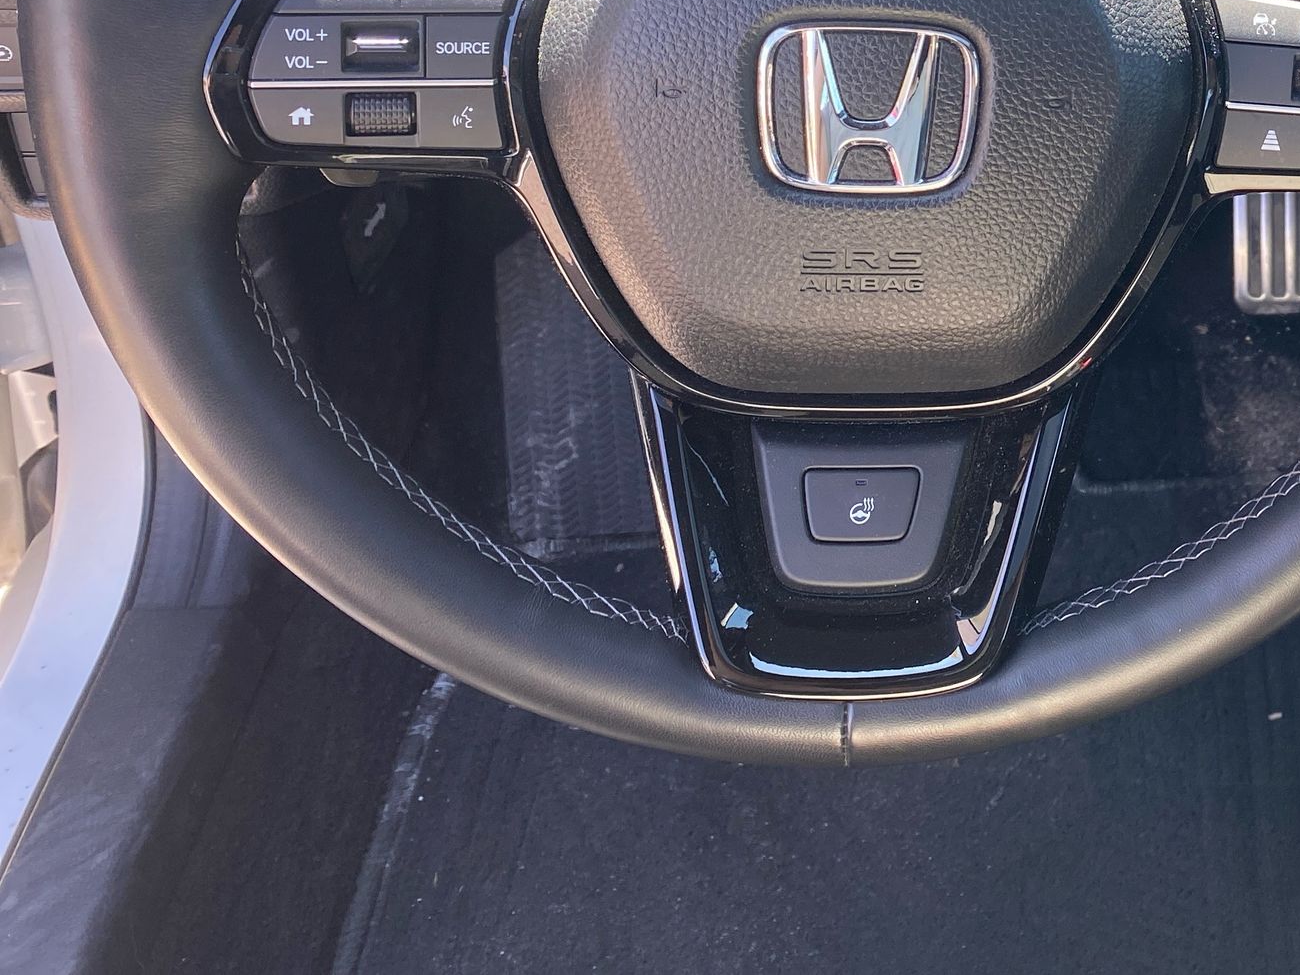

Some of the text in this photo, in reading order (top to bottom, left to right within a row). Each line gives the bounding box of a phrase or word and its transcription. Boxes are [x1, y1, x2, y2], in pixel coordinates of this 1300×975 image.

[435, 42, 490, 55] SOURCE
[802, 248, 923, 270] SRS
[800, 277, 925, 293] AIRBAG
